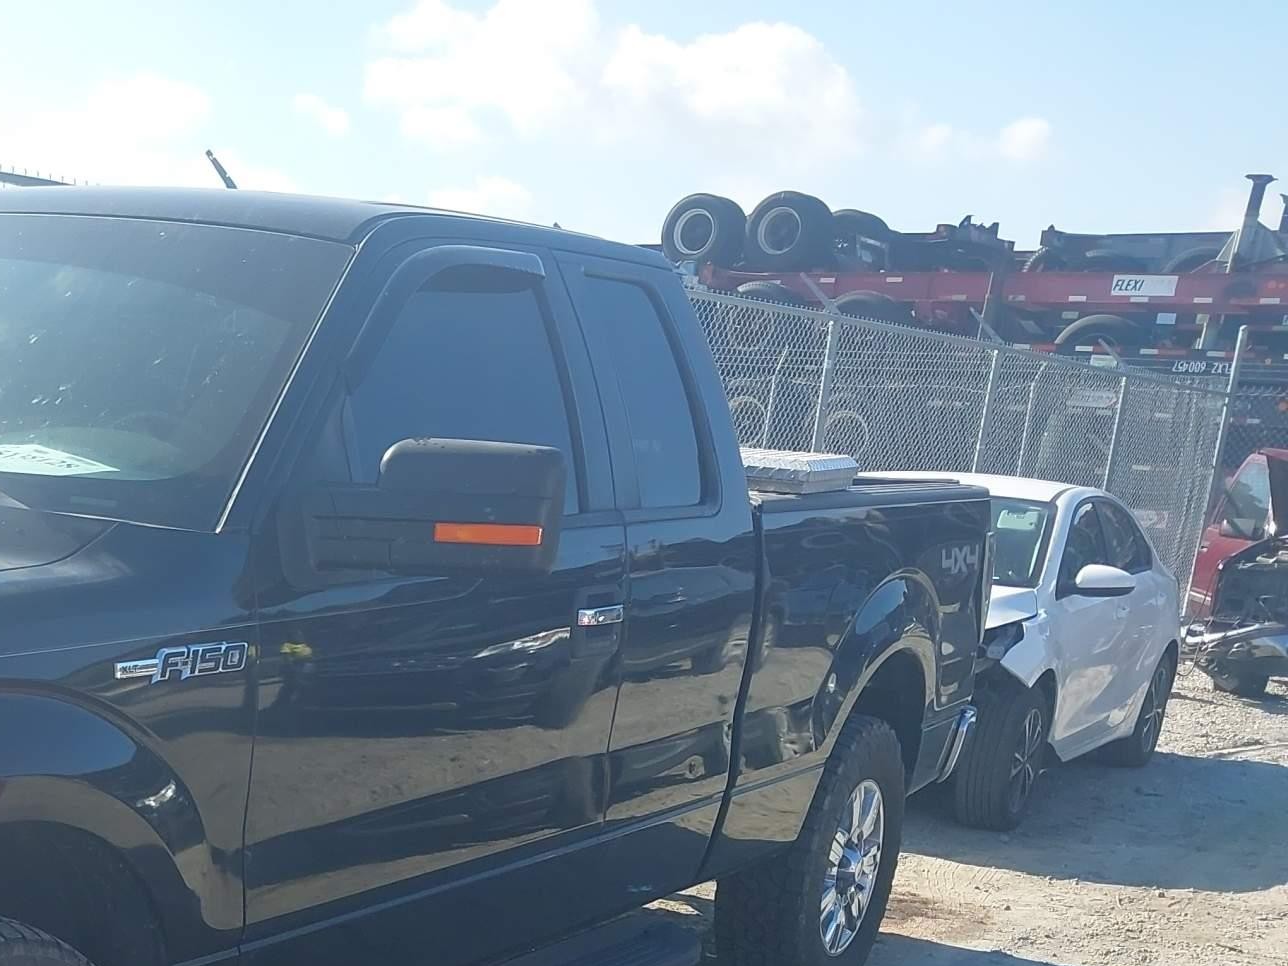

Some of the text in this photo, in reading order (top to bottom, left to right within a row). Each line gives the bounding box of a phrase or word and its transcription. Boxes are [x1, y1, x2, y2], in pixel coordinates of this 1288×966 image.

[1113, 279, 1145, 292] FLEXI
[1172, 360, 1207, 373] 600457
[941, 544, 979, 575] 4X4
